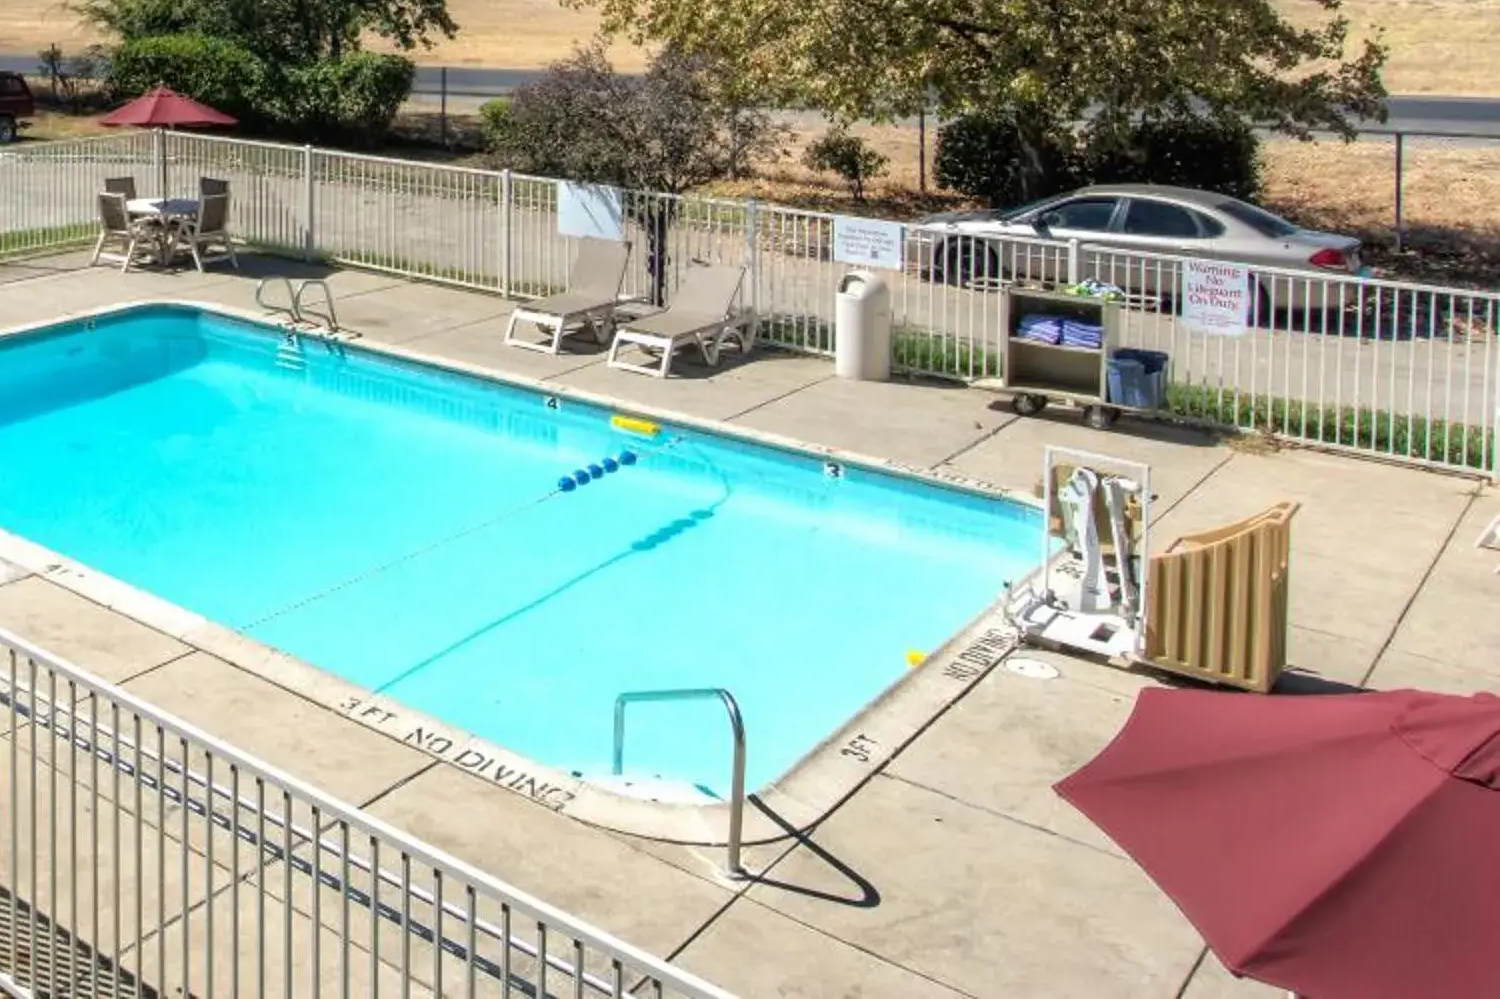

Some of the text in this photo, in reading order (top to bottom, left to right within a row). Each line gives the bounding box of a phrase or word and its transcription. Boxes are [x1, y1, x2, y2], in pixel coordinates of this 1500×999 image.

[1205, 274, 1222, 286] No
[547, 395, 558, 410] 4
[827, 462, 840, 478] 3
[401, 727, 453, 755] NO
[453, 749, 576, 813] DIVING
